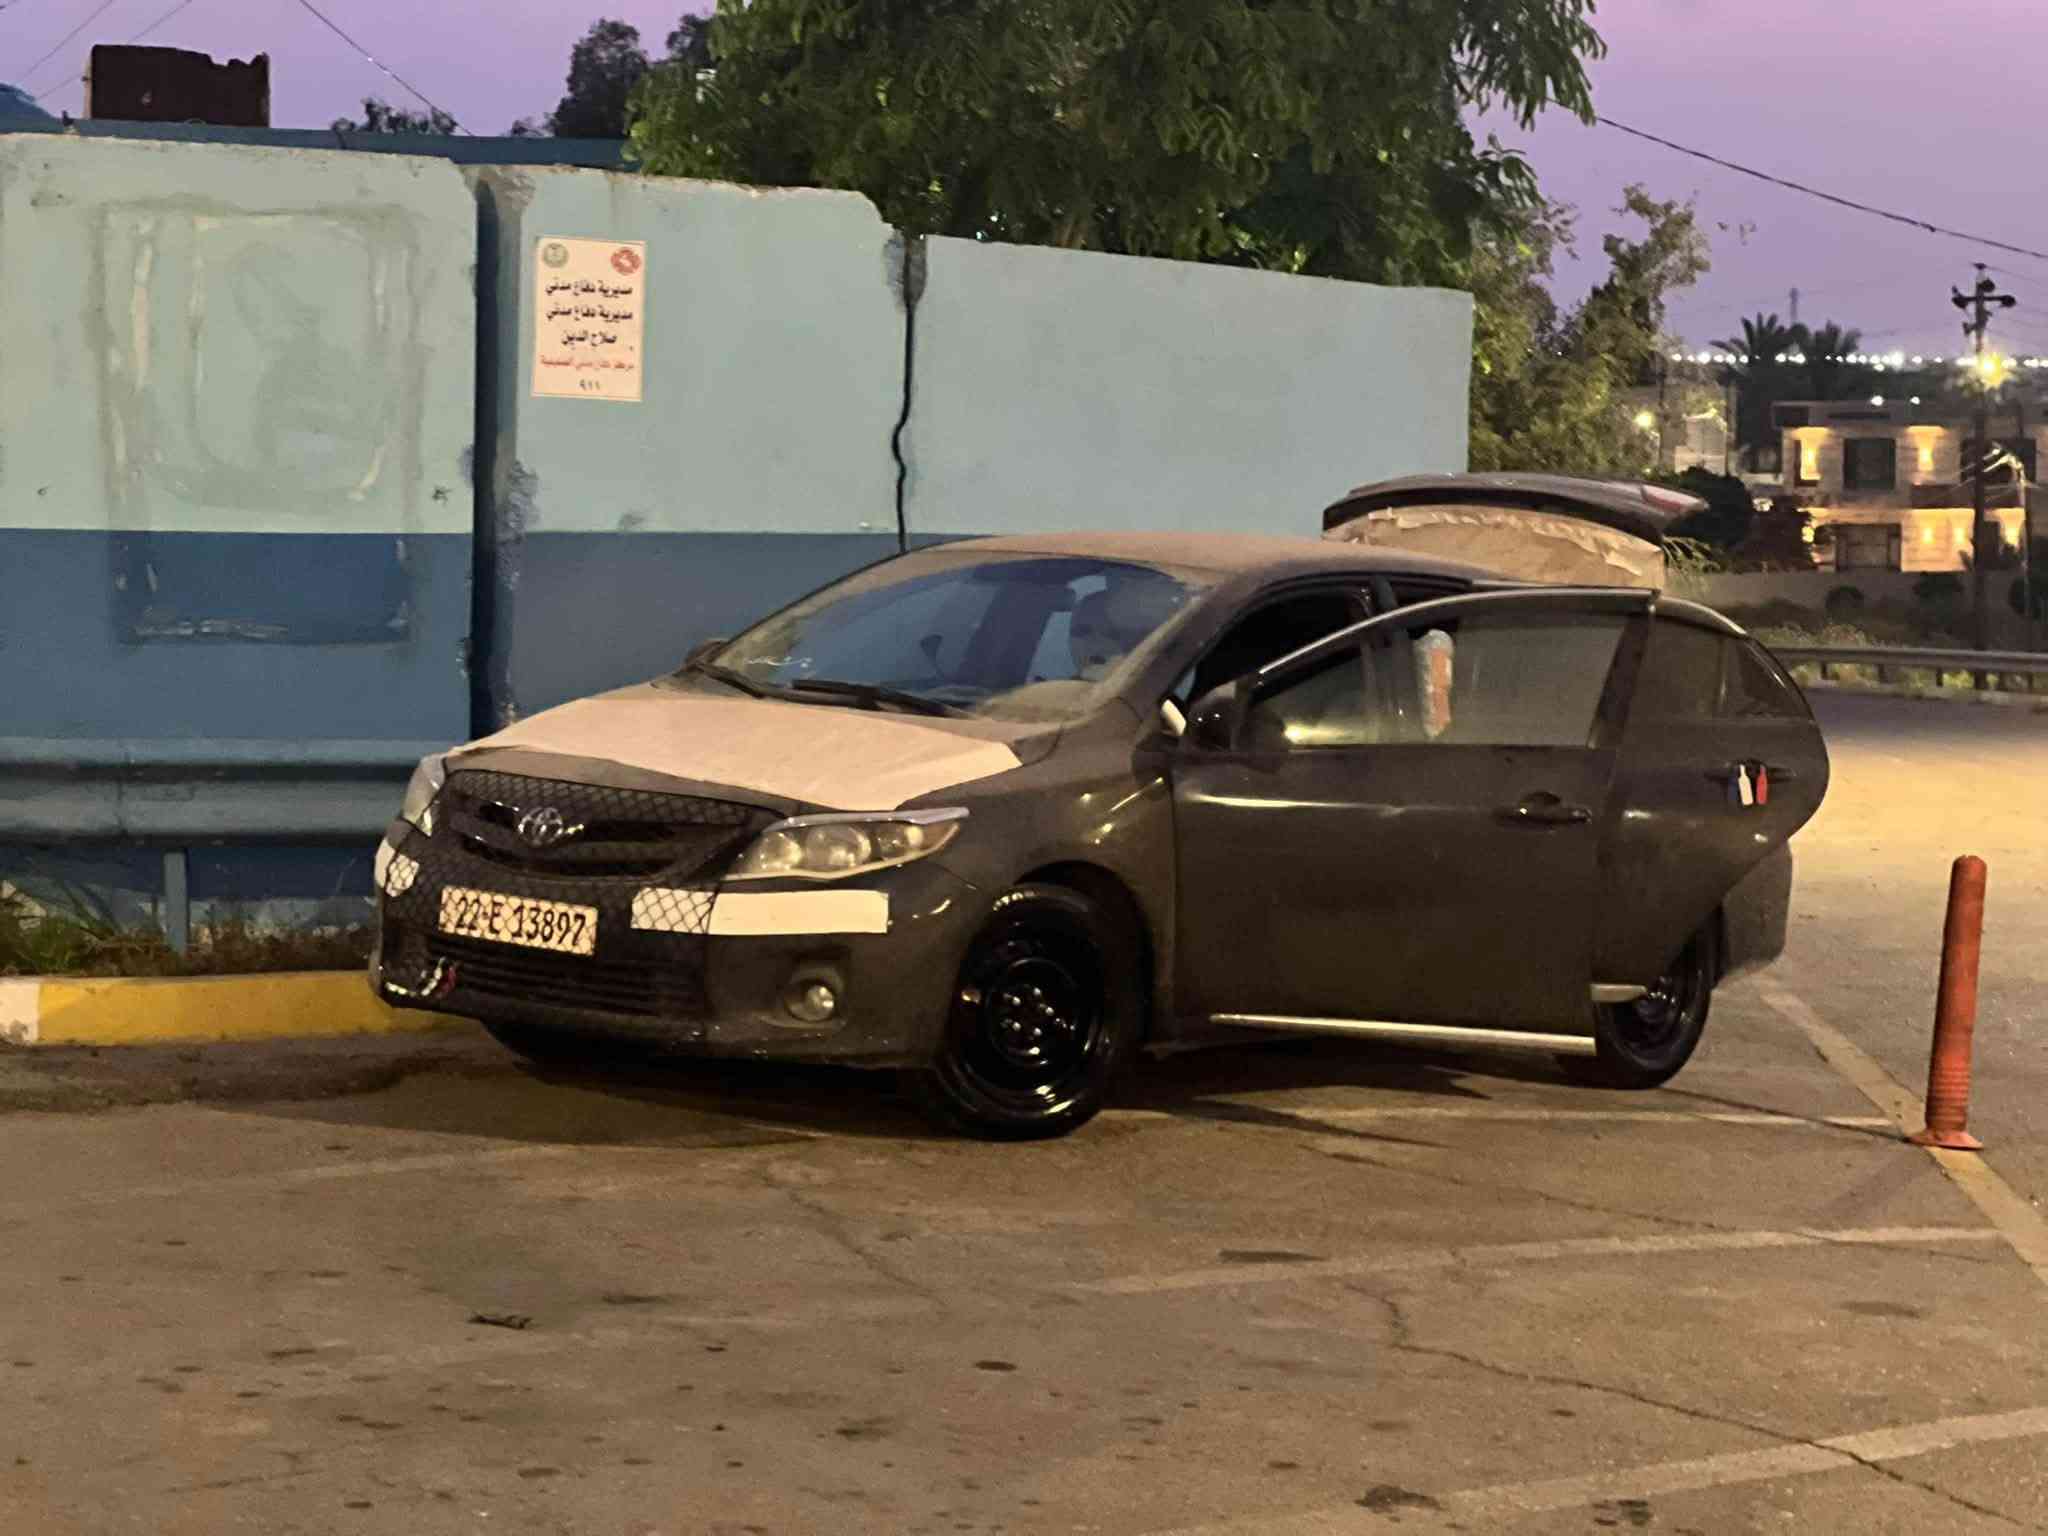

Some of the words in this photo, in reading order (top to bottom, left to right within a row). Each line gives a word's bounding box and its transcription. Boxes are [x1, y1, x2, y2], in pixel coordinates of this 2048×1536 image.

[546, 302, 572, 321] مدني
[573, 305, 595, 322] دفاع
[598, 304, 633, 324] مديرية
[561, 329, 588, 350] الدين
[511, 902, 587, 946] 13897
